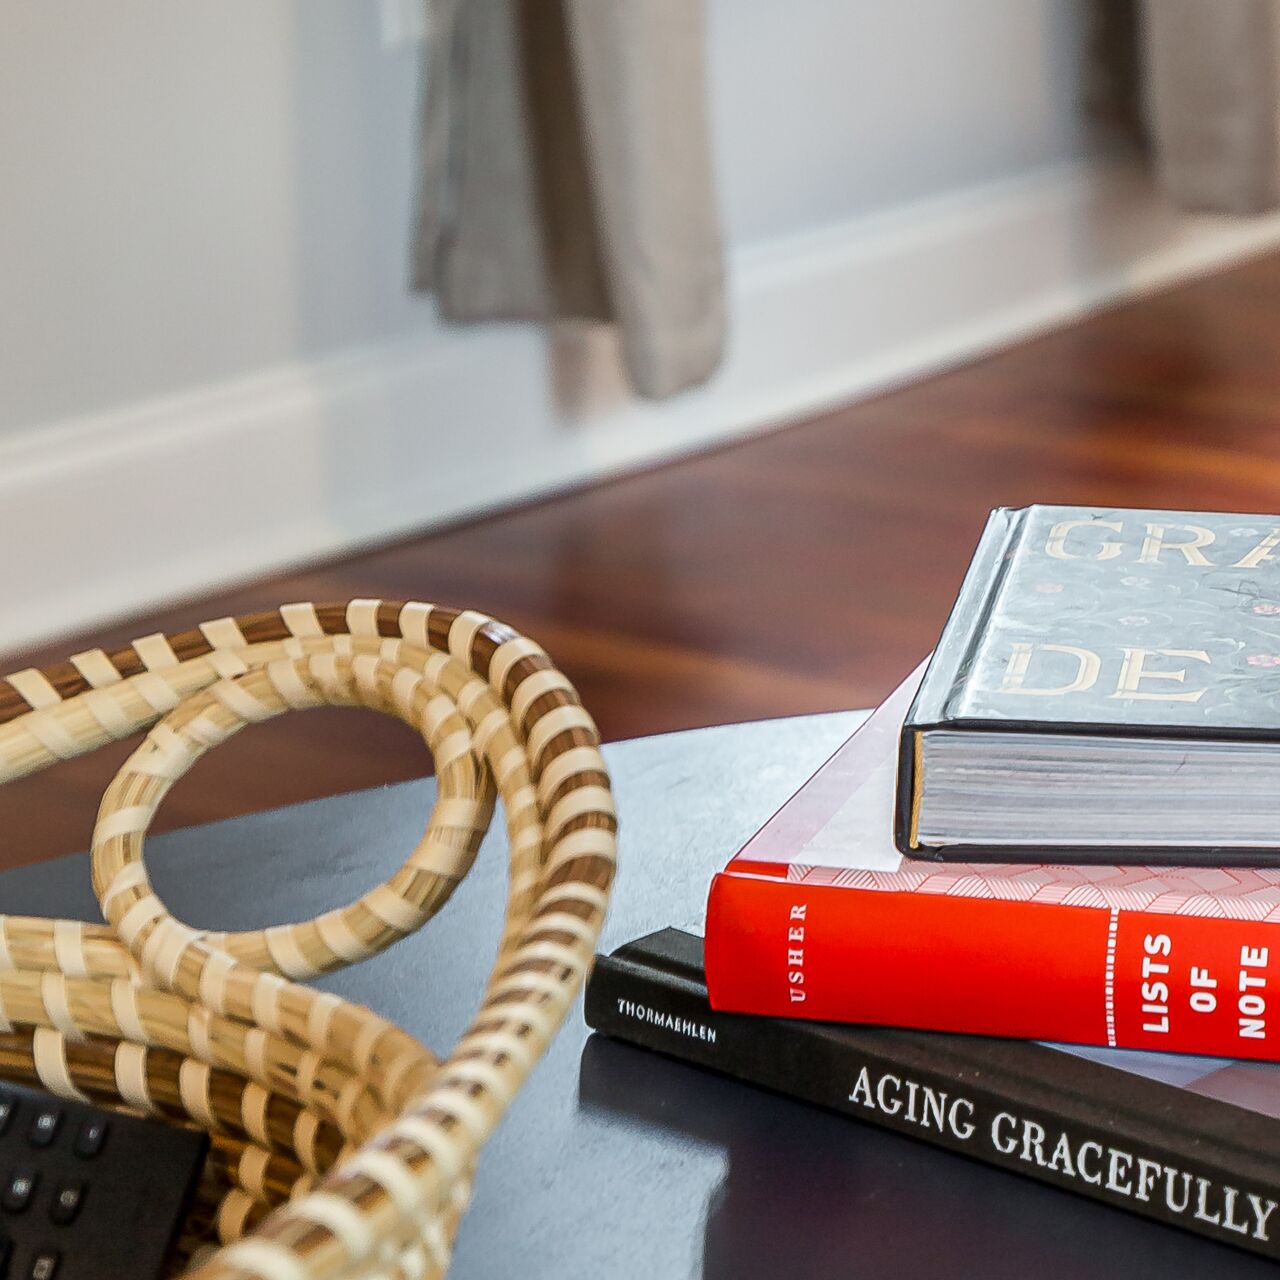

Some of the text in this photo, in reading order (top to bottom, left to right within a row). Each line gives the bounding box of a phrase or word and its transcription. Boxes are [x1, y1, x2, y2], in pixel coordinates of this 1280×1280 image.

[995, 642, 1212, 703] DE
[788, 903, 808, 1003] USHER
[1141, 933, 1173, 1034] LISTS
[1189, 966, 1218, 1013] OF
[1238, 945, 1270, 1039] NOTE
[617, 997, 717, 1044] THORMAEHLEN
[848, 1066, 1279, 1242] AGING GRACEFULLY
